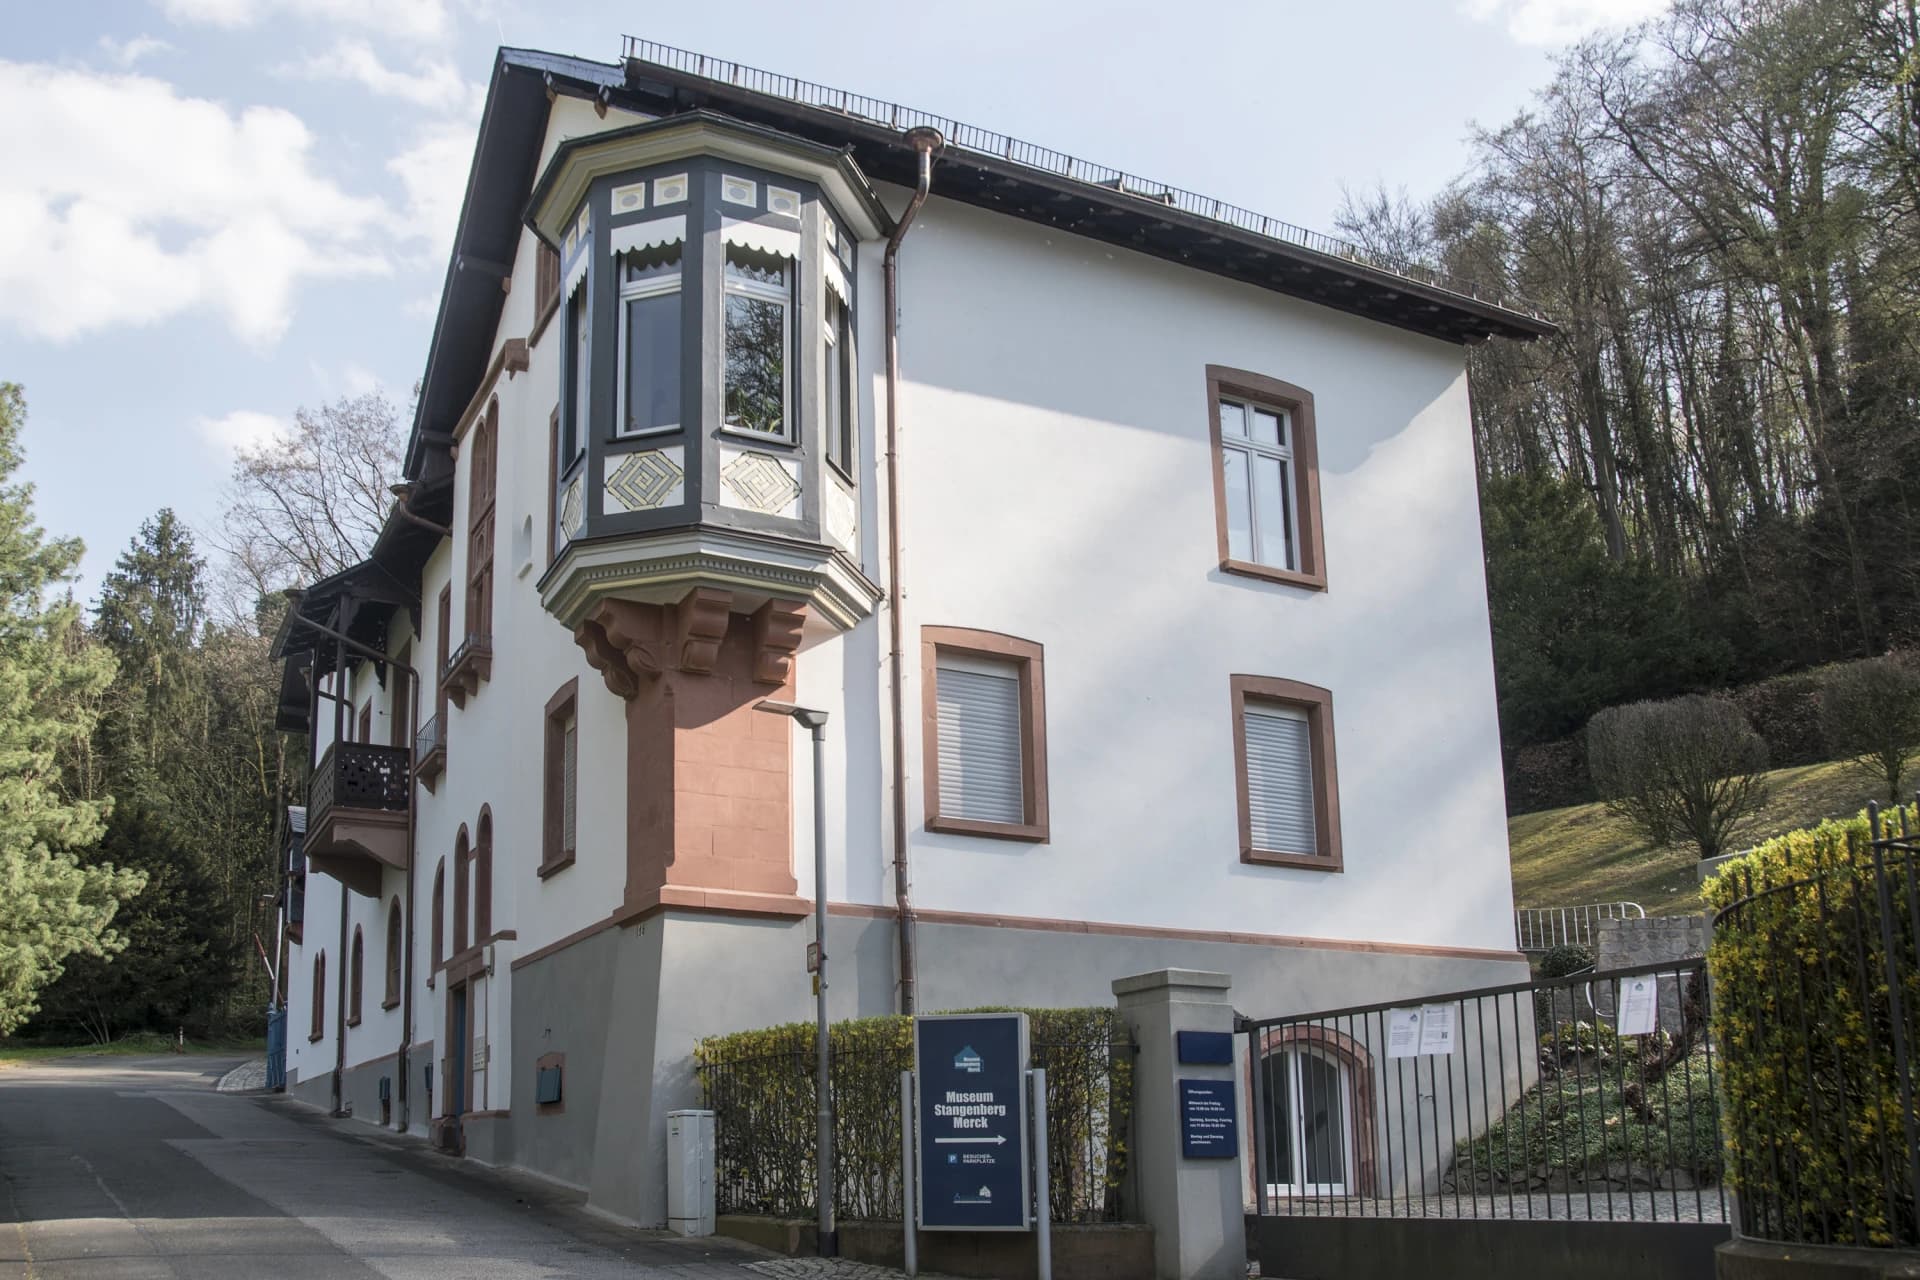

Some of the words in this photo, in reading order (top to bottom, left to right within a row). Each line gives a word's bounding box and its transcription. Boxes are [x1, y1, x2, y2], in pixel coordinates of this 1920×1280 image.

[946, 1091, 994, 1103] Museum
[934, 1104, 1006, 1117] Stangenberg
[953, 1117, 988, 1128] Merck
